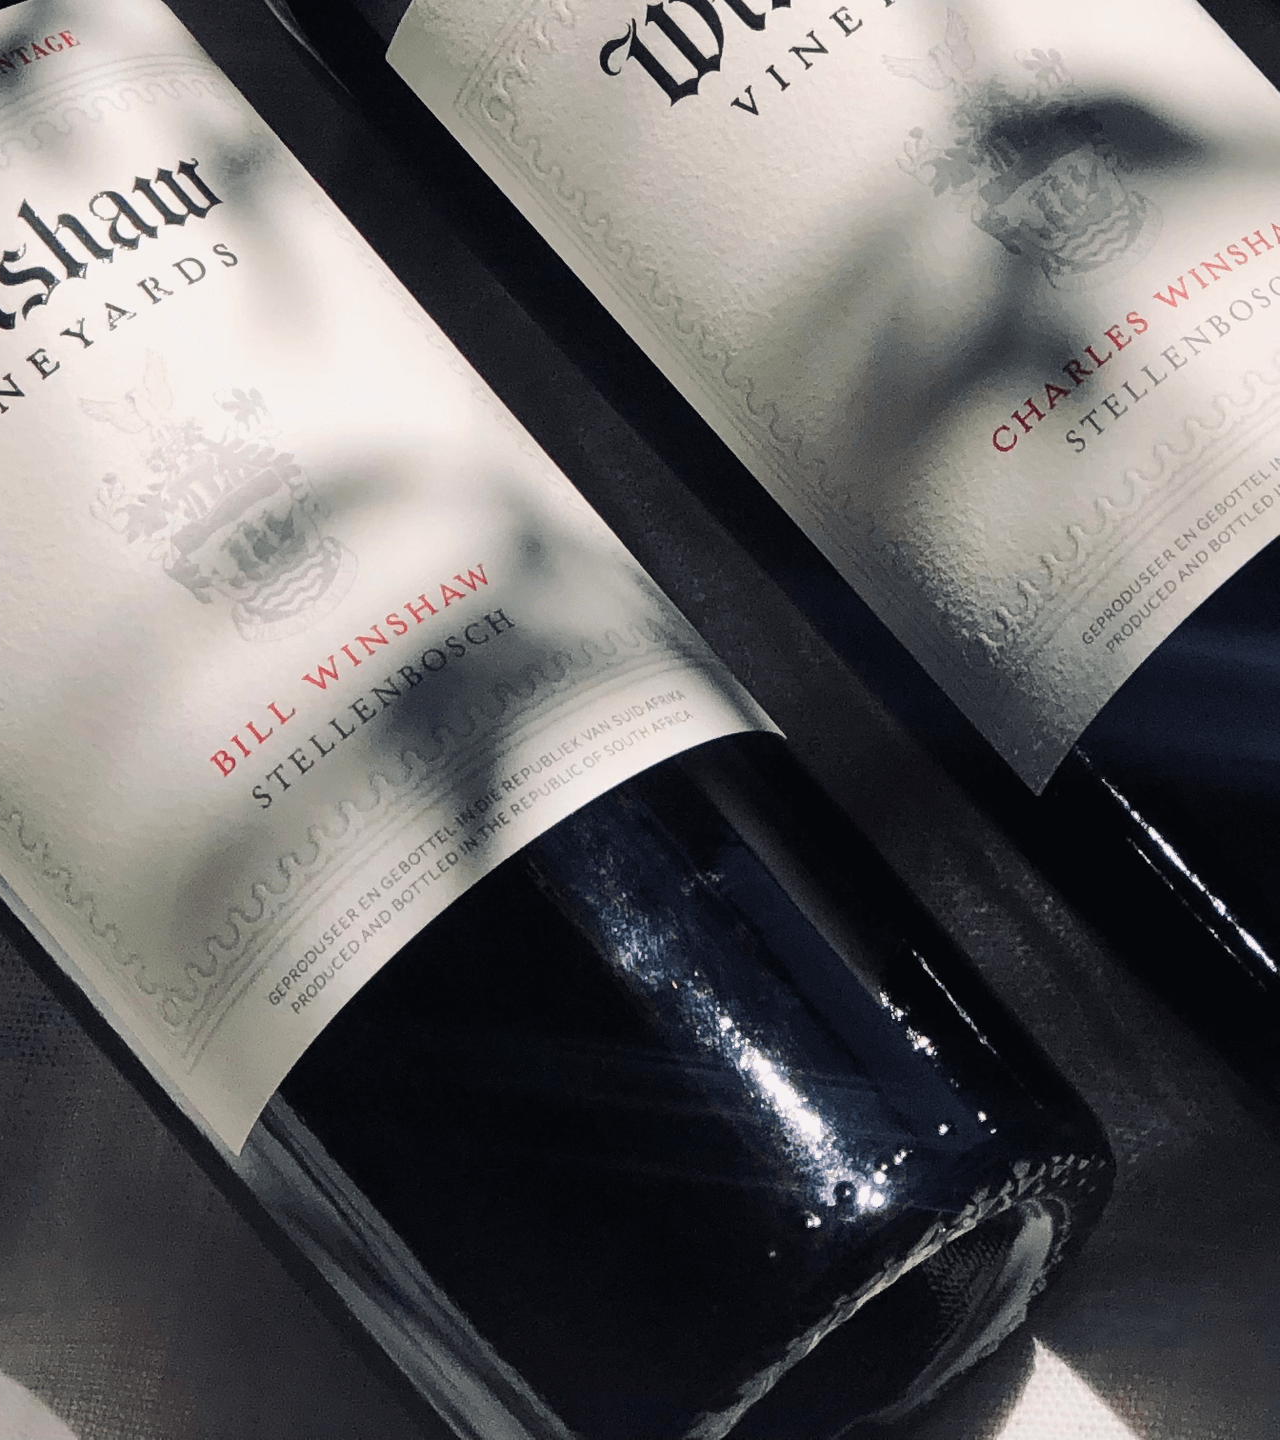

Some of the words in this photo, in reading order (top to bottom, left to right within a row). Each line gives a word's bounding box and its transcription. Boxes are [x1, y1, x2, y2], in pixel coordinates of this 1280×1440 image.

[990, 310, 1150, 453] CHARLES
[1082, 548, 1176, 645] GEPRODUSEER
[1173, 528, 1198, 552] EN
[1196, 467, 1271, 532] GEBOTTEL
[1106, 578, 1177, 654] PRODUCED
[1177, 548, 1210, 583] AND
[1208, 492, 1275, 552] BOTTLED
[209, 702, 298, 779] BILL
[301, 562, 490, 691] WINSHAW
[250, 607, 517, 810] STELLENBOSCH
[269, 908, 359, 1006] GEPRODUSEER
[358, 887, 381, 910] EN
[381, 825, 457, 890] GEBOTTEL
[455, 809, 475, 829] IN
[475, 790, 503, 814] DIE
[502, 737, 585, 793] REPUBLIEK
[582, 720, 611, 741] VAN
[611, 689, 687, 726] SUID-AFRIKA
[291, 940, 361, 1015] PRODUCED
[361, 910, 392, 943] AND
[391, 851, 459, 913] BOTTLED
[460, 835, 479, 856] IN
[477, 812, 511, 839] THE
[509, 763, 584, 816] REPUBLIC
[582, 751, 603, 769] OF
[603, 727, 650, 757] SOUTH
[652, 709, 693, 734] AFRICA
